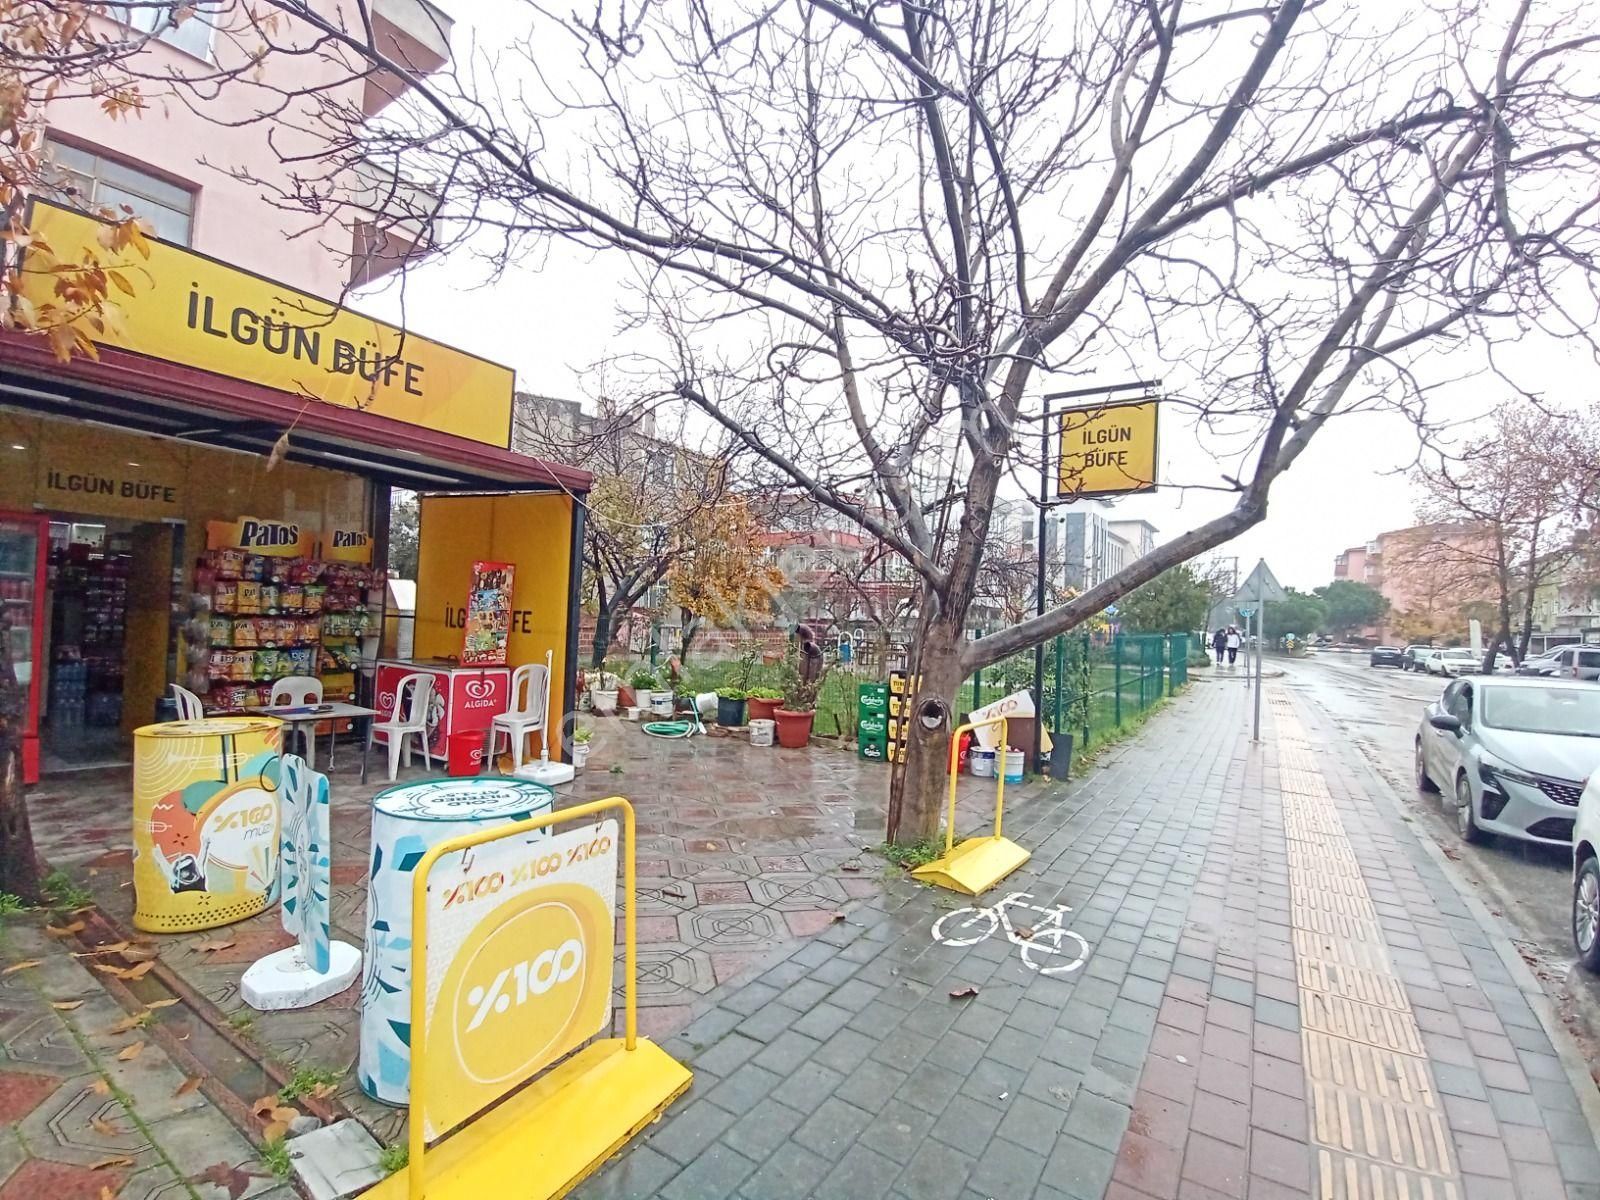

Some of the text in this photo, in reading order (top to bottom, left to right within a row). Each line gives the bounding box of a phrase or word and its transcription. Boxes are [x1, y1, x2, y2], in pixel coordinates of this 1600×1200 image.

[187, 281, 424, 396] İLGÜN BÜFE
[1082, 424, 1132, 445] İLGÜN
[1084, 448, 1129, 468] BÜFE
[47, 467, 177, 503] İLGÜN BÜFE
[445, 602, 533, 633] İLG FE
[214, 803, 273, 833] %100
[442, 871, 505, 910] %100
[465, 938, 584, 1033] %100
